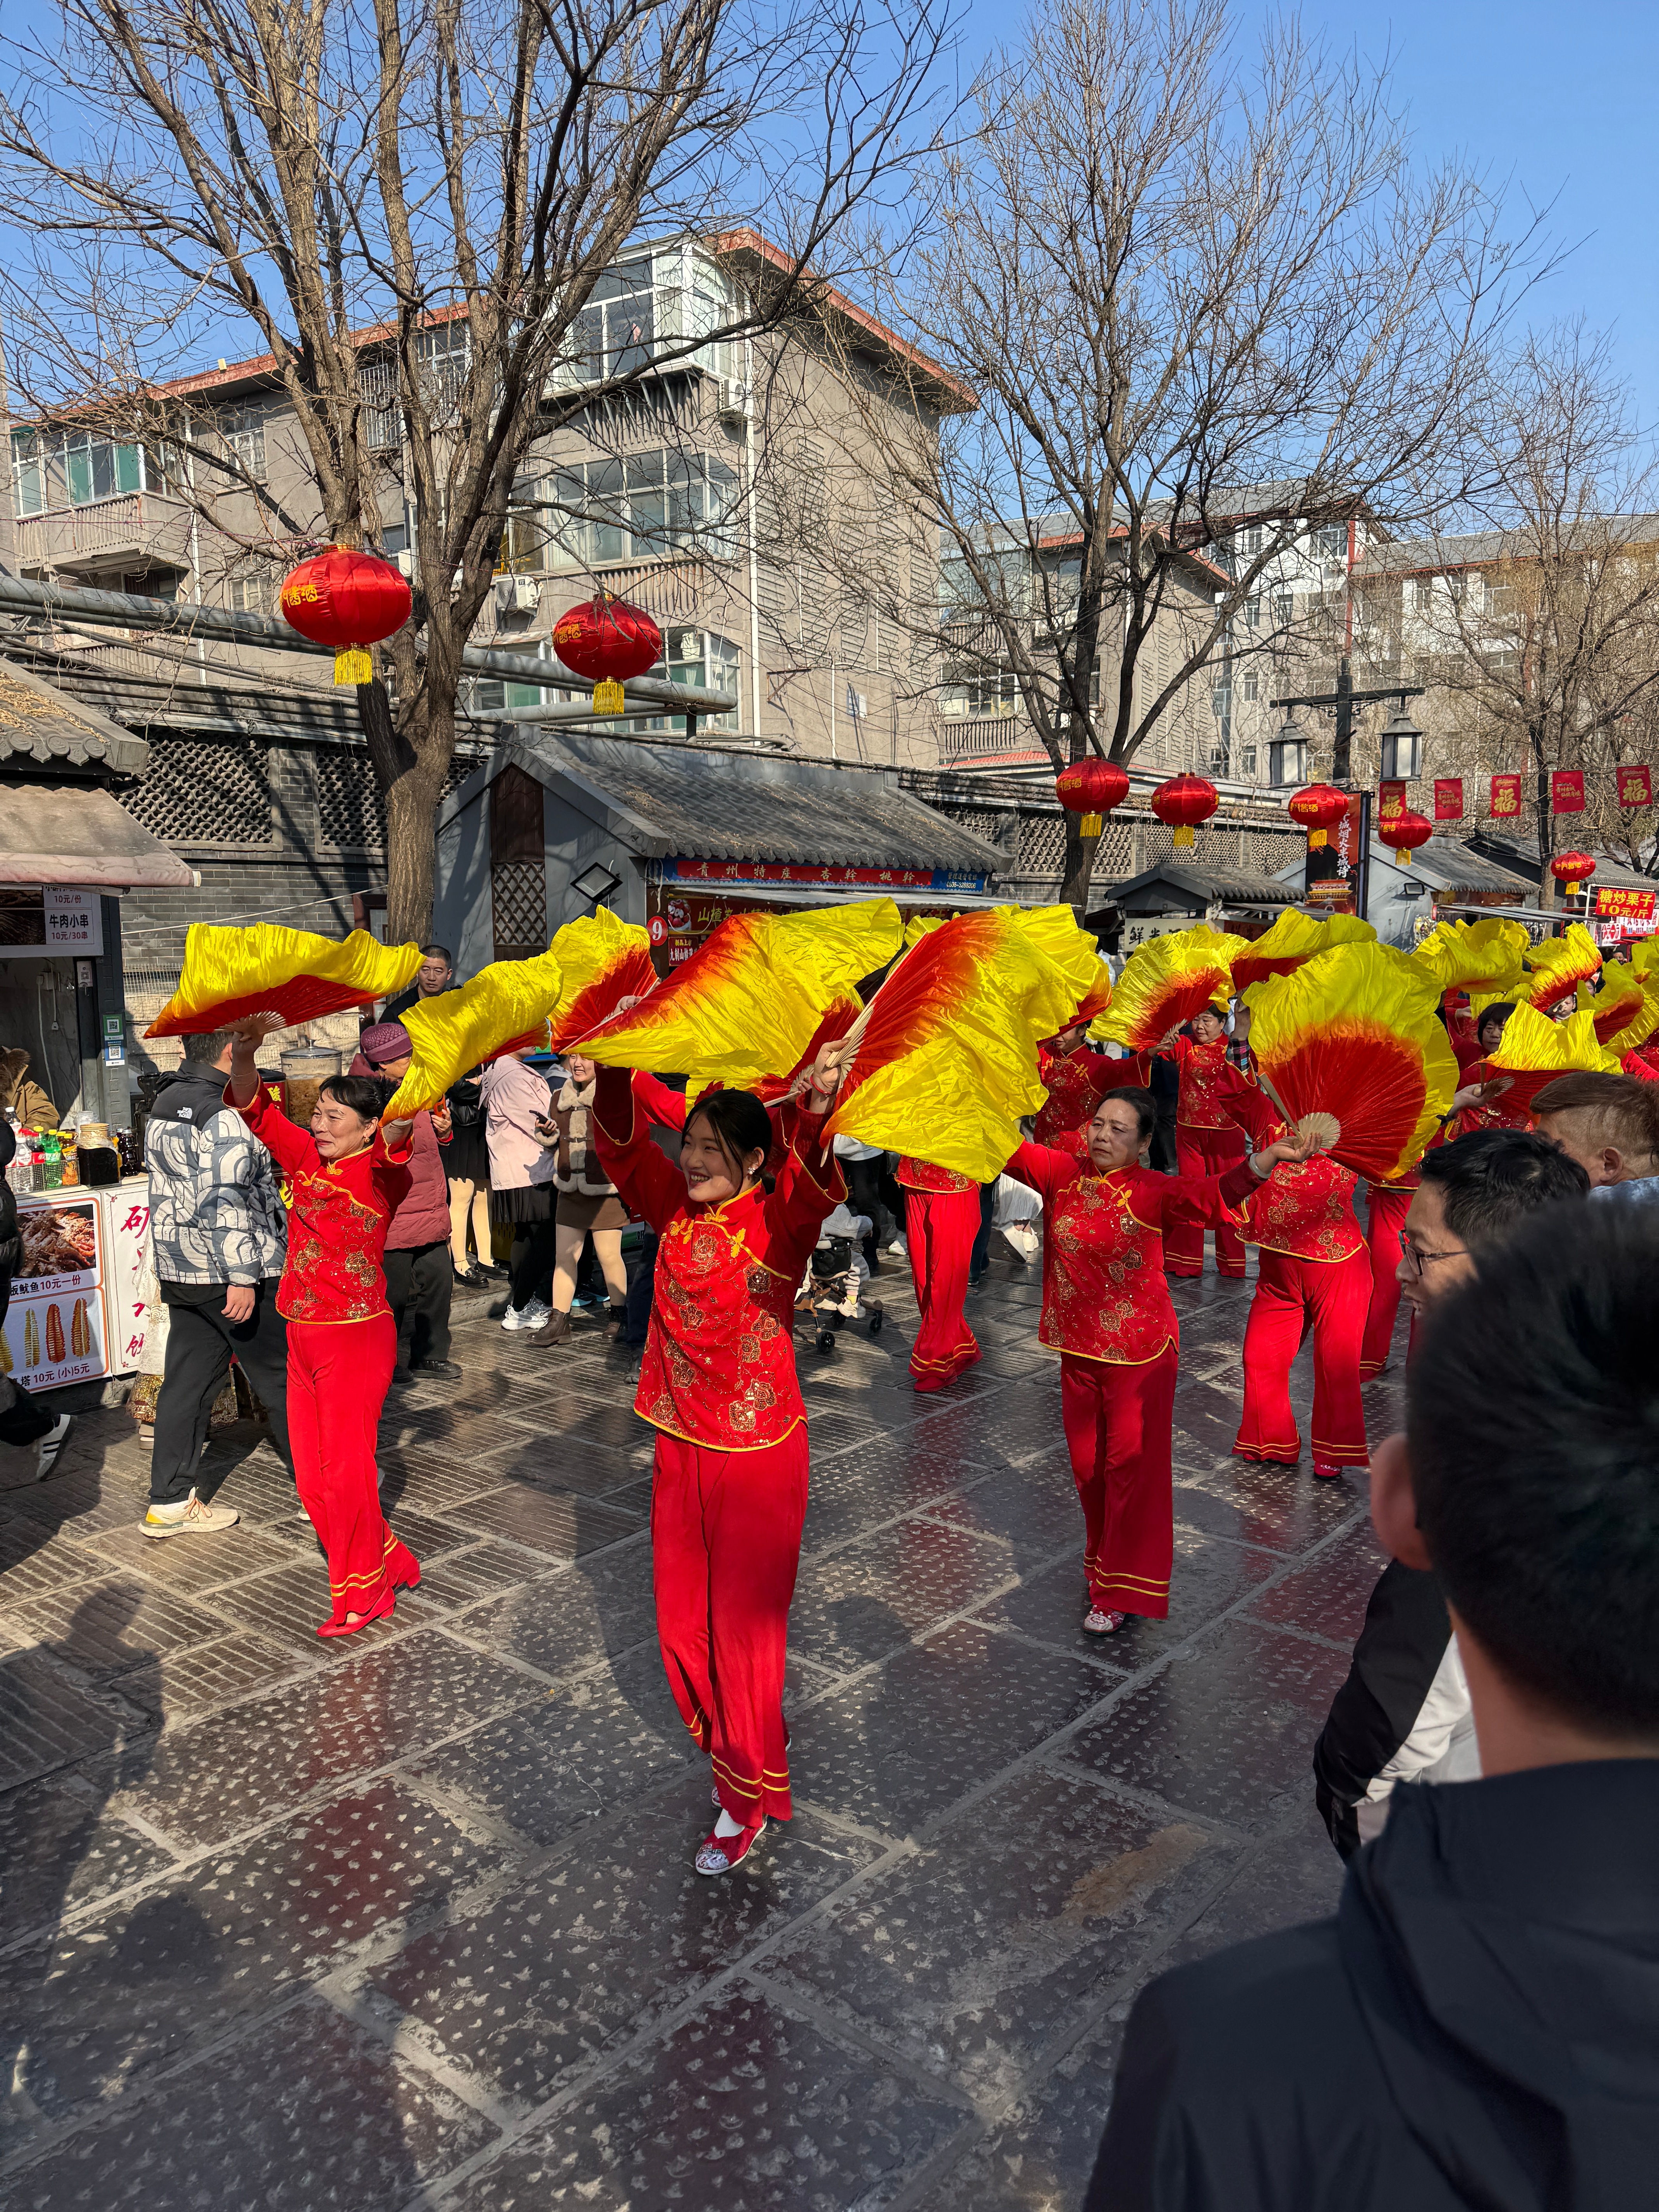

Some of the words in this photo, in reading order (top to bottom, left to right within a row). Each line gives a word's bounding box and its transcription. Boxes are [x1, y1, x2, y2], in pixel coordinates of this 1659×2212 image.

[1623, 778, 1648, 802] 福
[1381, 795, 1403, 818] 福
[1494, 788, 1518, 813] 福
[54, 895, 81, 903] 10元/份
[1599, 889, 1654, 907] 糖炒栗子
[1599, 904, 1649, 919] 10元/斤
[49, 914, 89, 928] 牛肉小串
[52, 931, 88, 940] 10元/30串
[653, 922, 662, 941] 9
